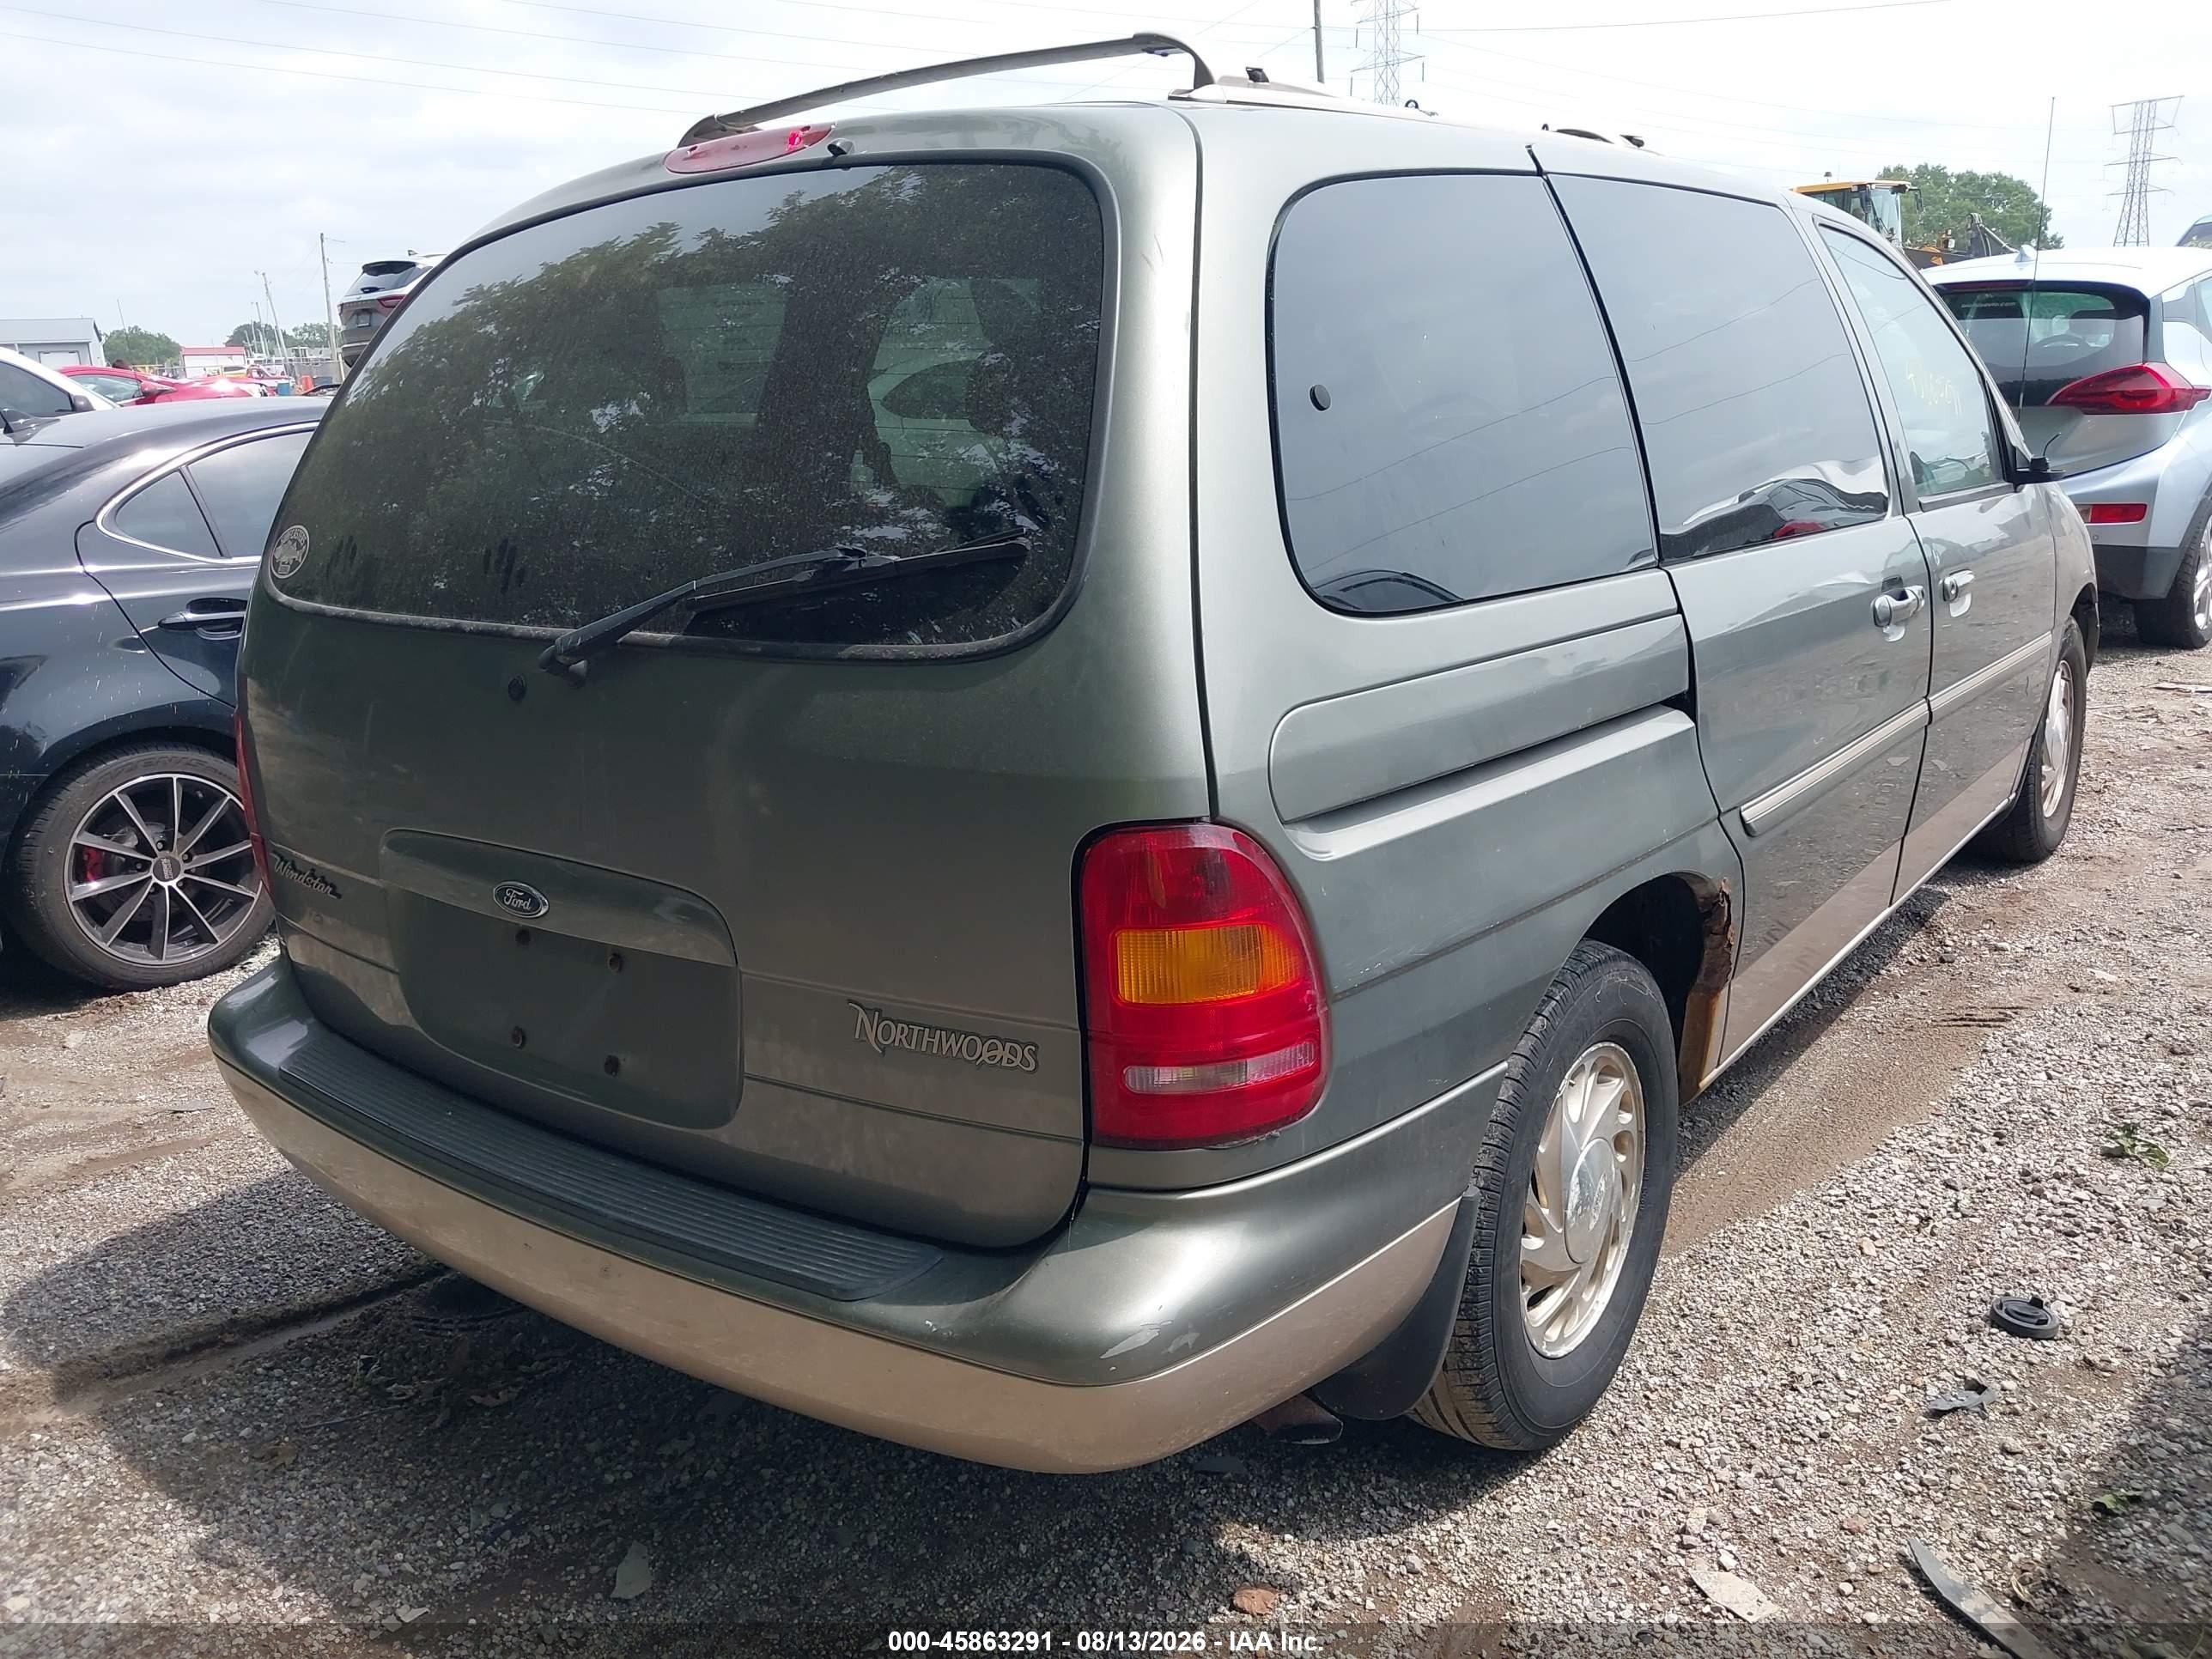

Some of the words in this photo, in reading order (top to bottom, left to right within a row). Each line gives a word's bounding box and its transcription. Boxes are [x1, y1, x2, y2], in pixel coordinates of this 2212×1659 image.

[269, 852, 339, 899] Windstar
[503, 888, 532, 910] Ford
[848, 1001, 1037, 1073] NORTHWOODS
